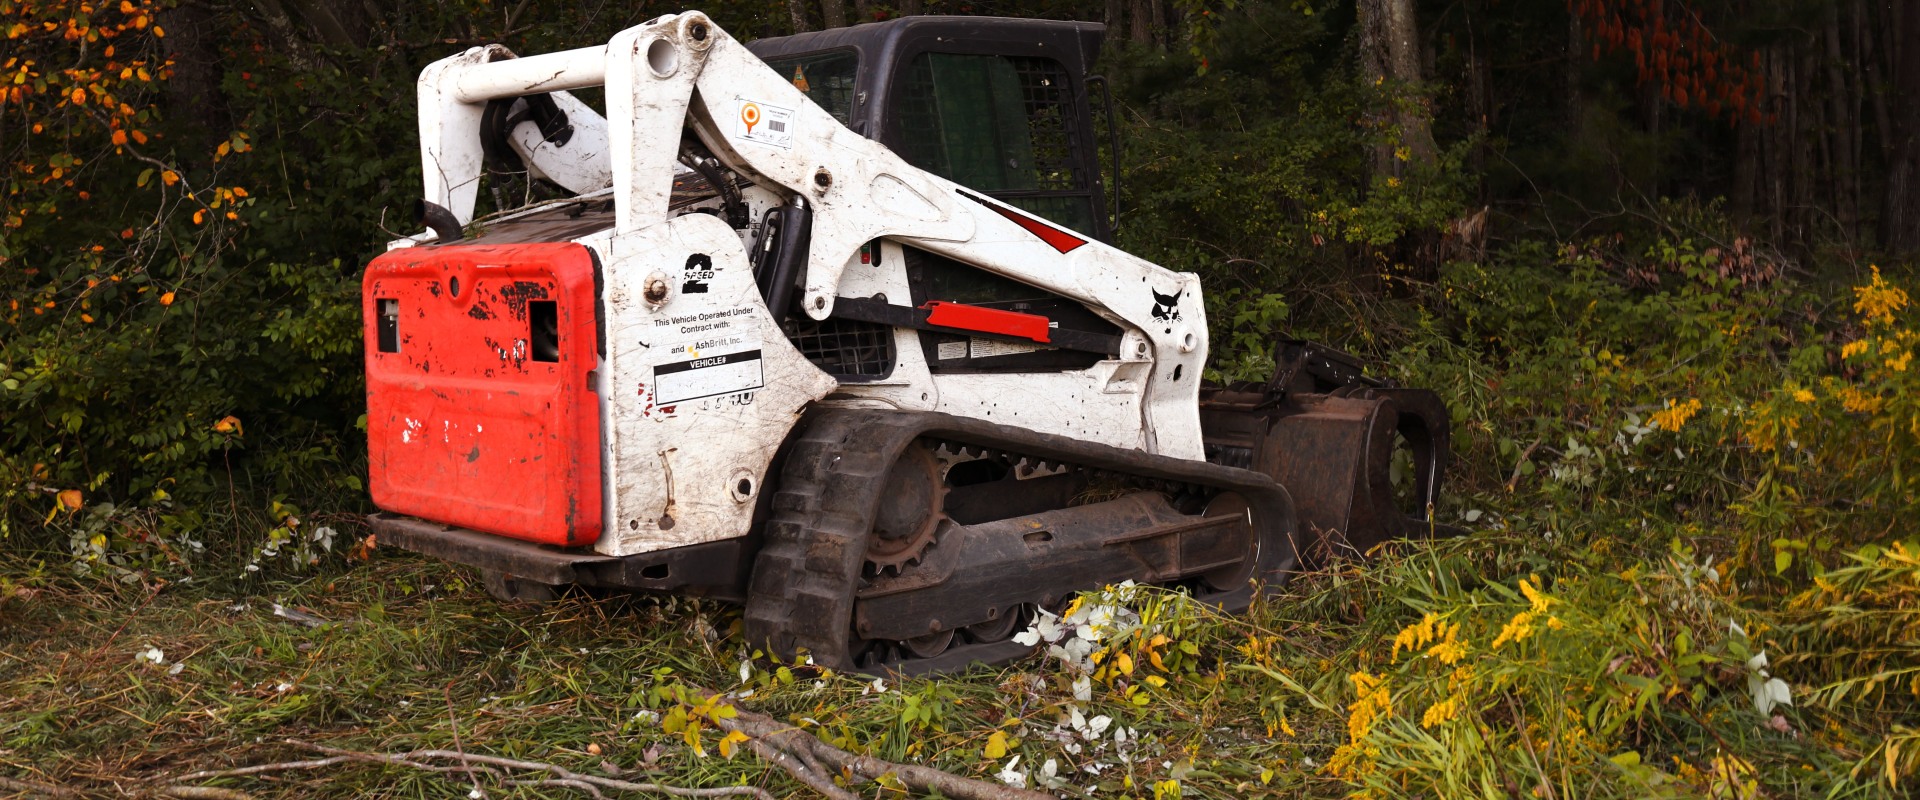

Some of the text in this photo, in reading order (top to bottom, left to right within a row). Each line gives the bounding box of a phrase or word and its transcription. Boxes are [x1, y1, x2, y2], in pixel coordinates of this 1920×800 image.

[682, 253, 712, 294] 2
[684, 271, 714, 280] SPEED
[654, 307, 754, 327] This Vehicle Operated Under
[680, 320, 731, 334] Contract with:
[671, 345, 685, 354] and
[695, 339, 728, 350] AshBritt,
[690, 356, 727, 369] VEHICLE#
